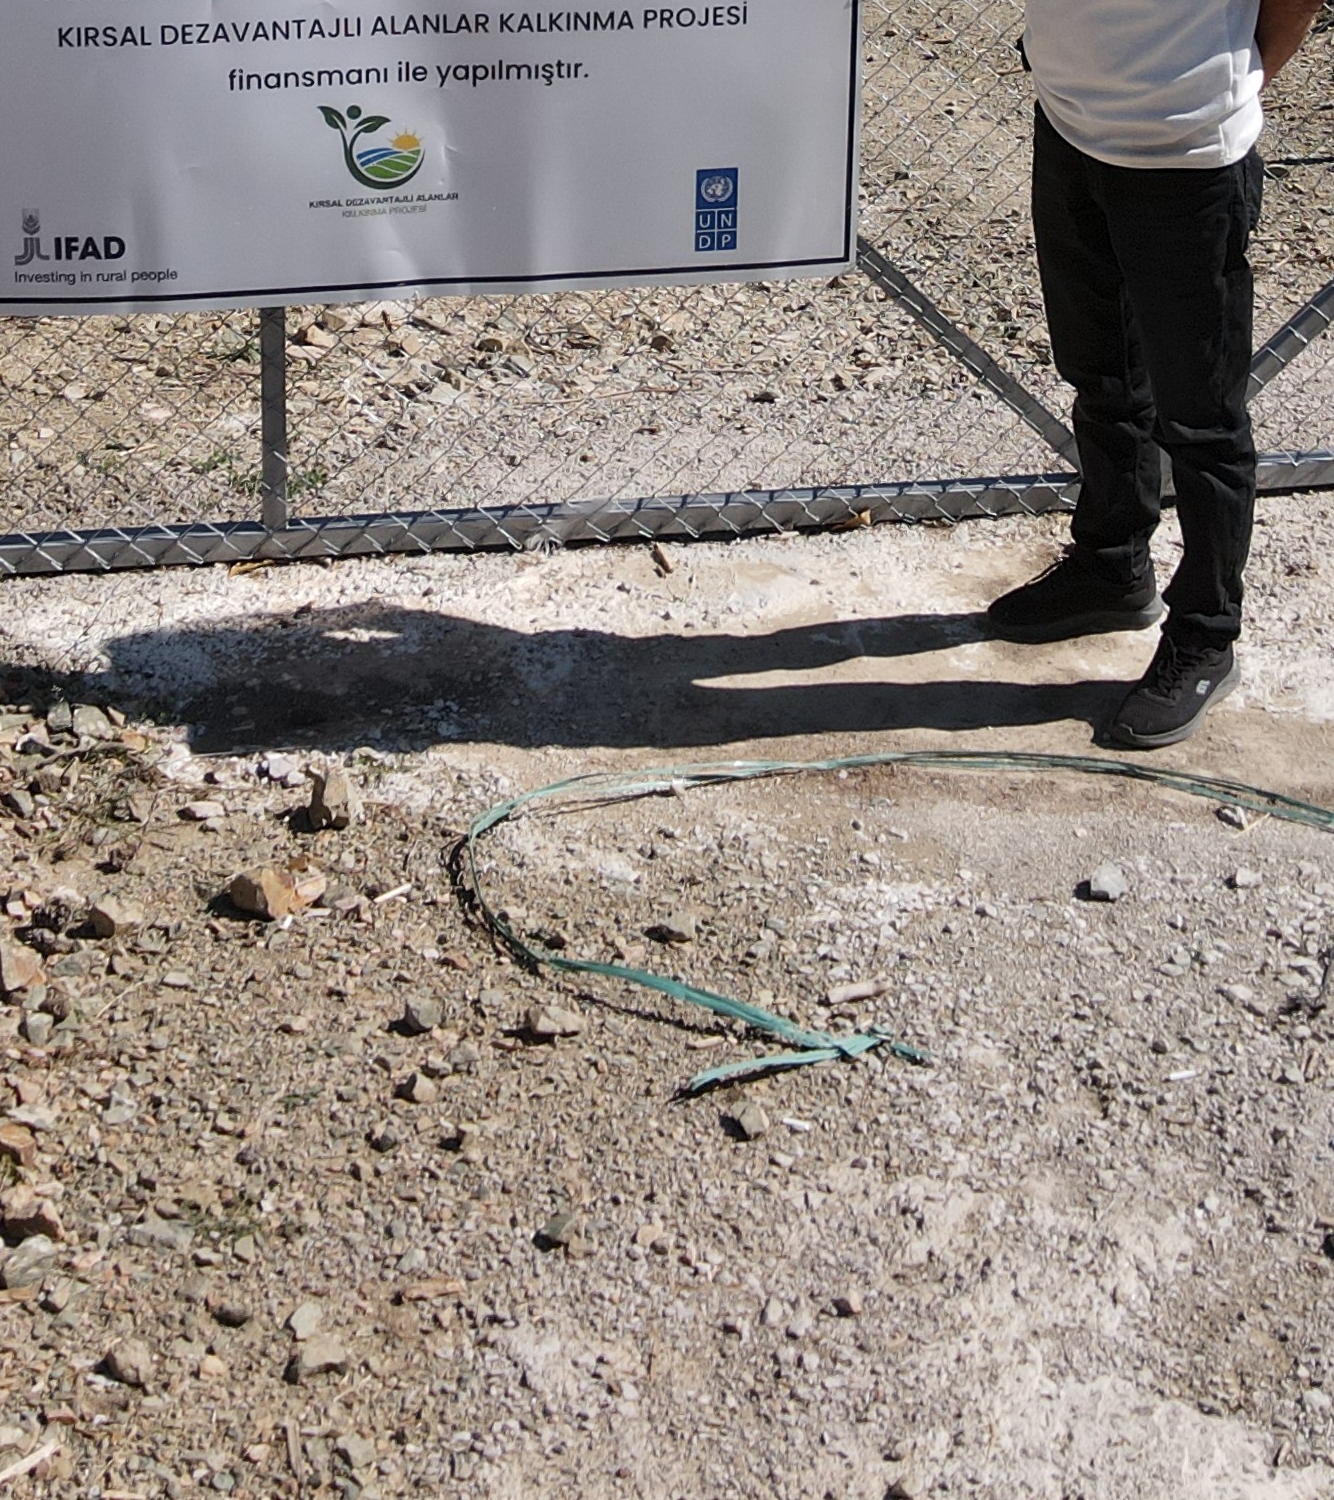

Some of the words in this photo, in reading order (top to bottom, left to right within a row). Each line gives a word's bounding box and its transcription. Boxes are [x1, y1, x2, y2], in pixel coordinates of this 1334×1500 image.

[57, 26, 153, 48] KIRSAL
[160, 16, 362, 46] DEZAVANTAJLI
[370, 13, 490, 37] ALANLAR
[499, 10, 635, 34] KALKINMA
[643, 1, 749, 30] PROJESİ
[228, 66, 389, 92] finansmanı
[397, 60, 428, 83] ile
[435, 59, 590, 88] yapılmıştır.
[308, 199, 343, 209] KIRSAL
[416, 192, 459, 202] ALANLAR
[54, 236, 126, 260] IFAD
[14, 270, 76, 285] Investing
[80, 271, 93, 282] in
[96, 269, 127, 282] rural
[131, 268, 178, 283] people
